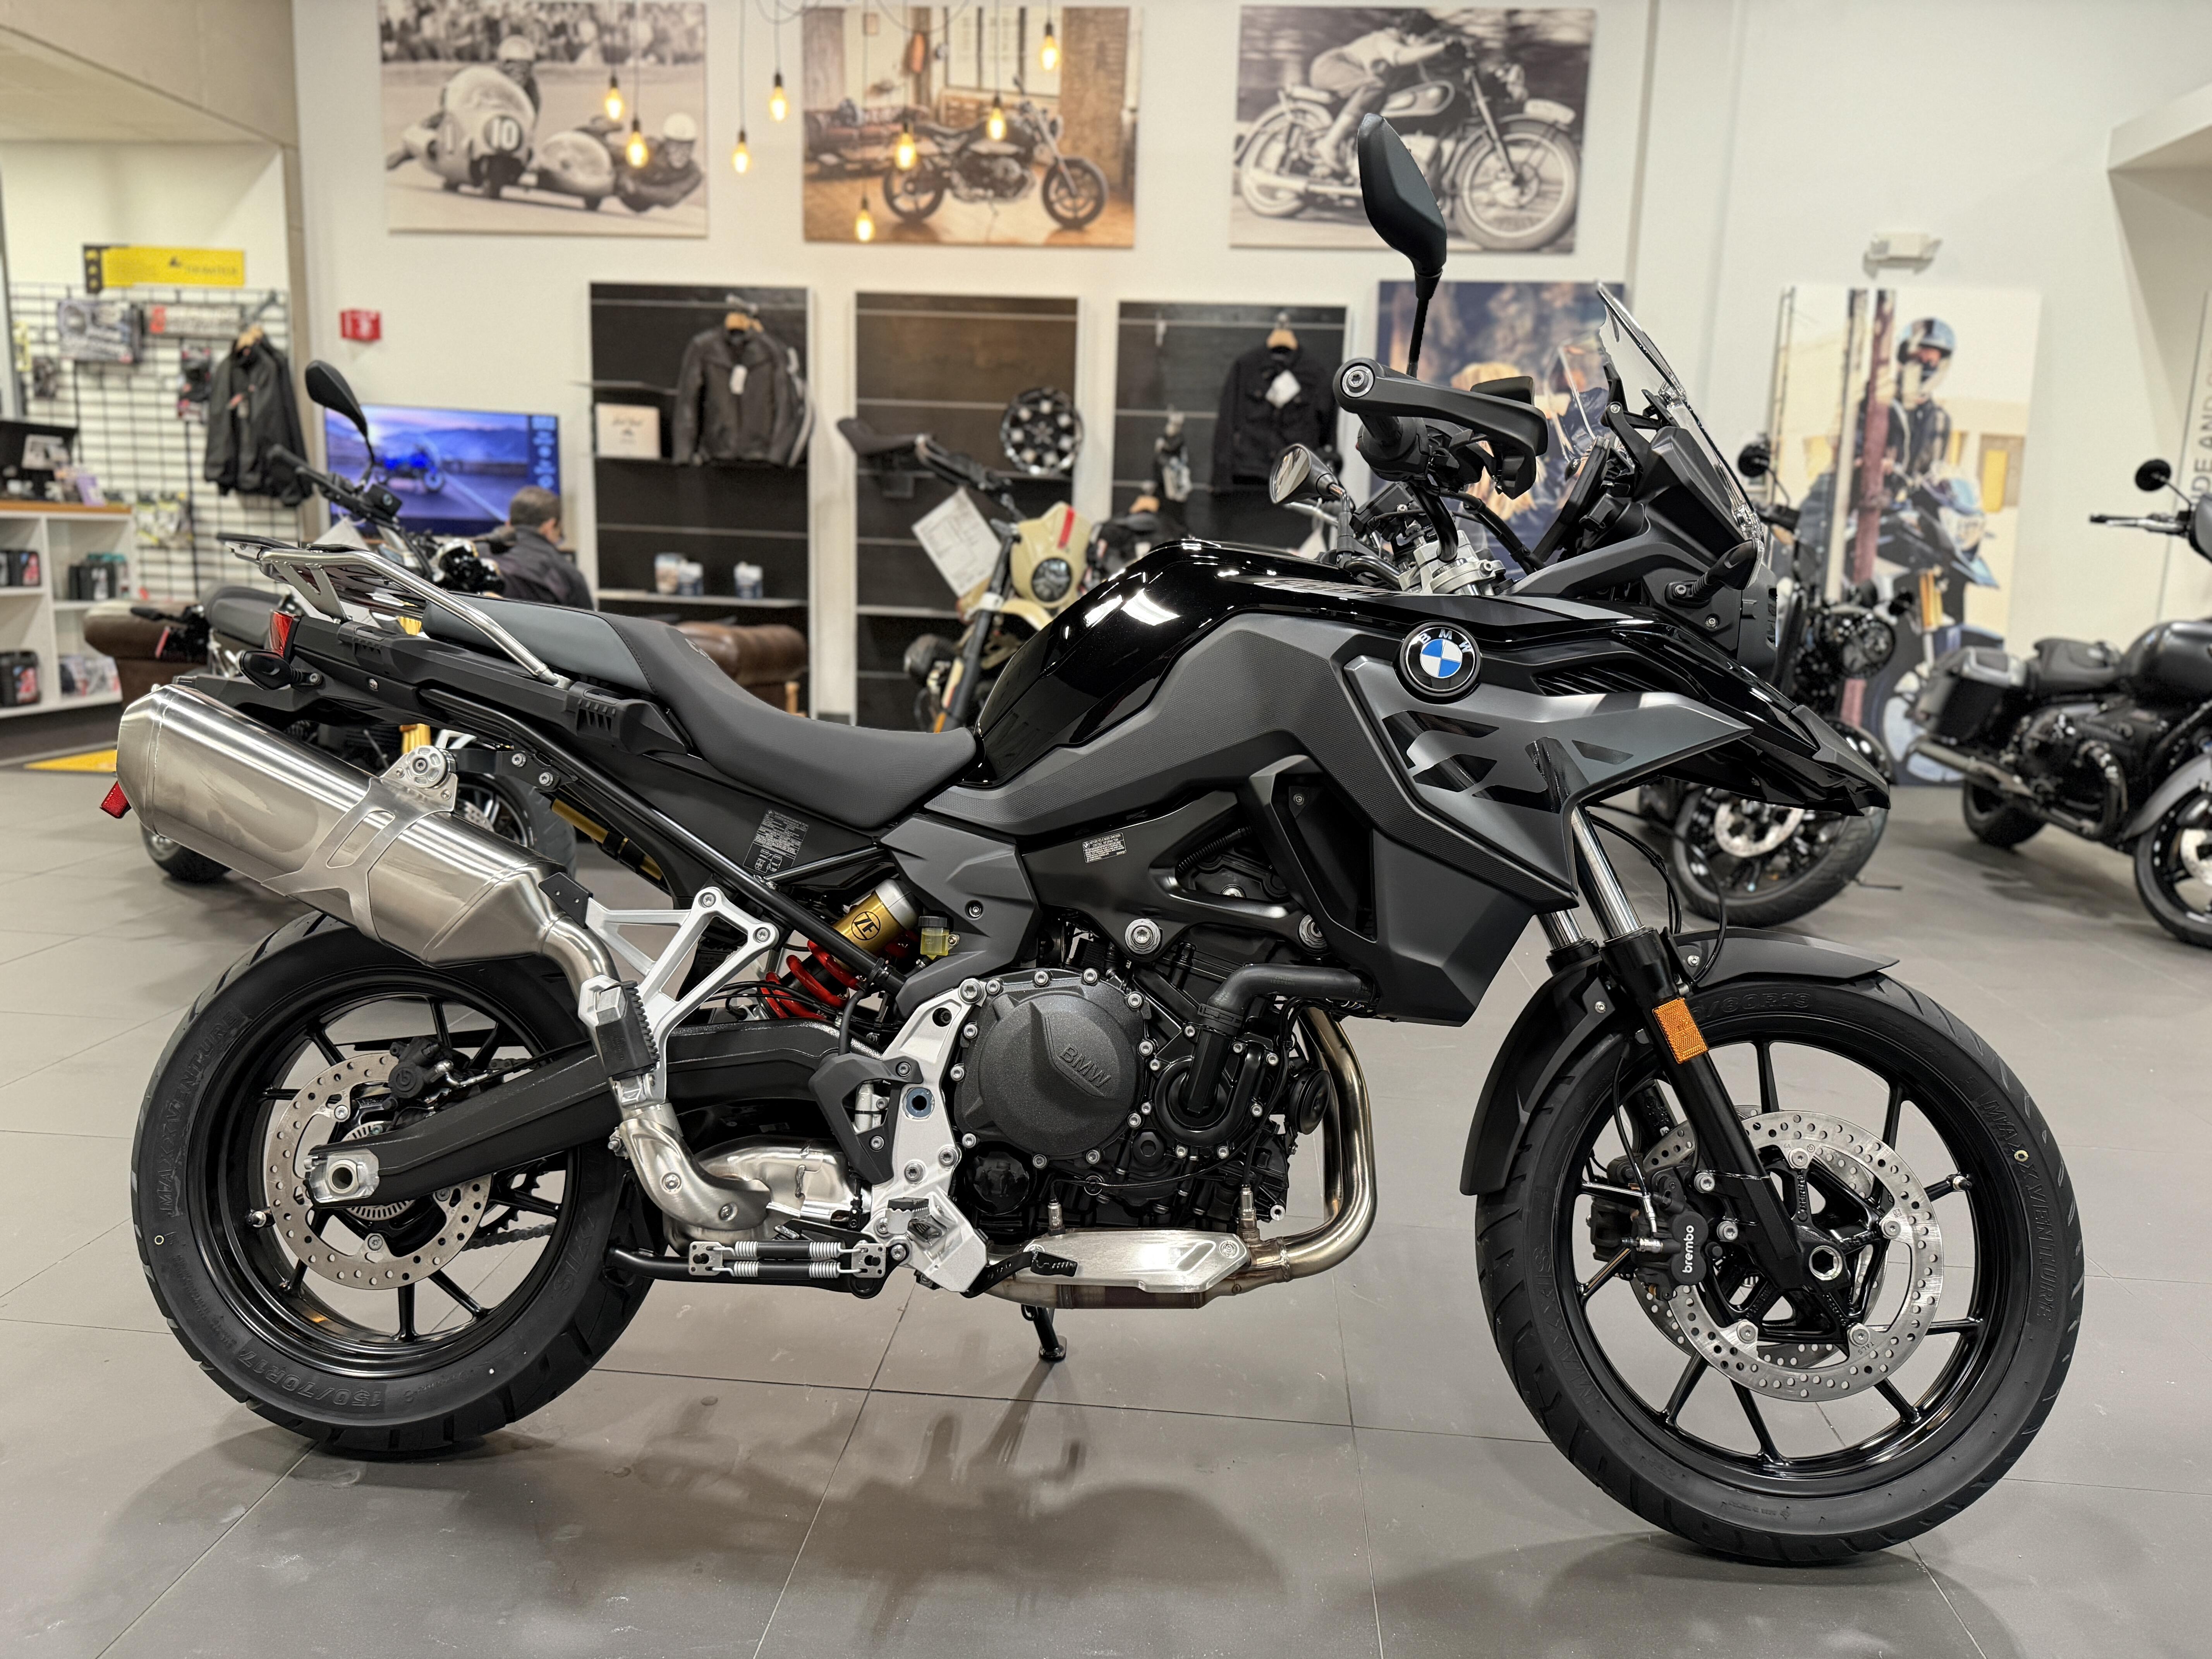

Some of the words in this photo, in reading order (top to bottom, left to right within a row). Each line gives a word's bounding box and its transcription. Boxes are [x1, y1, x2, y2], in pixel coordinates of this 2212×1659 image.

[491, 118, 519, 151] 10
[1418, 628, 1473, 653] BMW
[852, 912, 880, 940] ZF
[1060, 1043, 1111, 1088] BMW
[1682, 1225, 1695, 1273] brembo
[238, 1349, 383, 1408] 150/70R17
